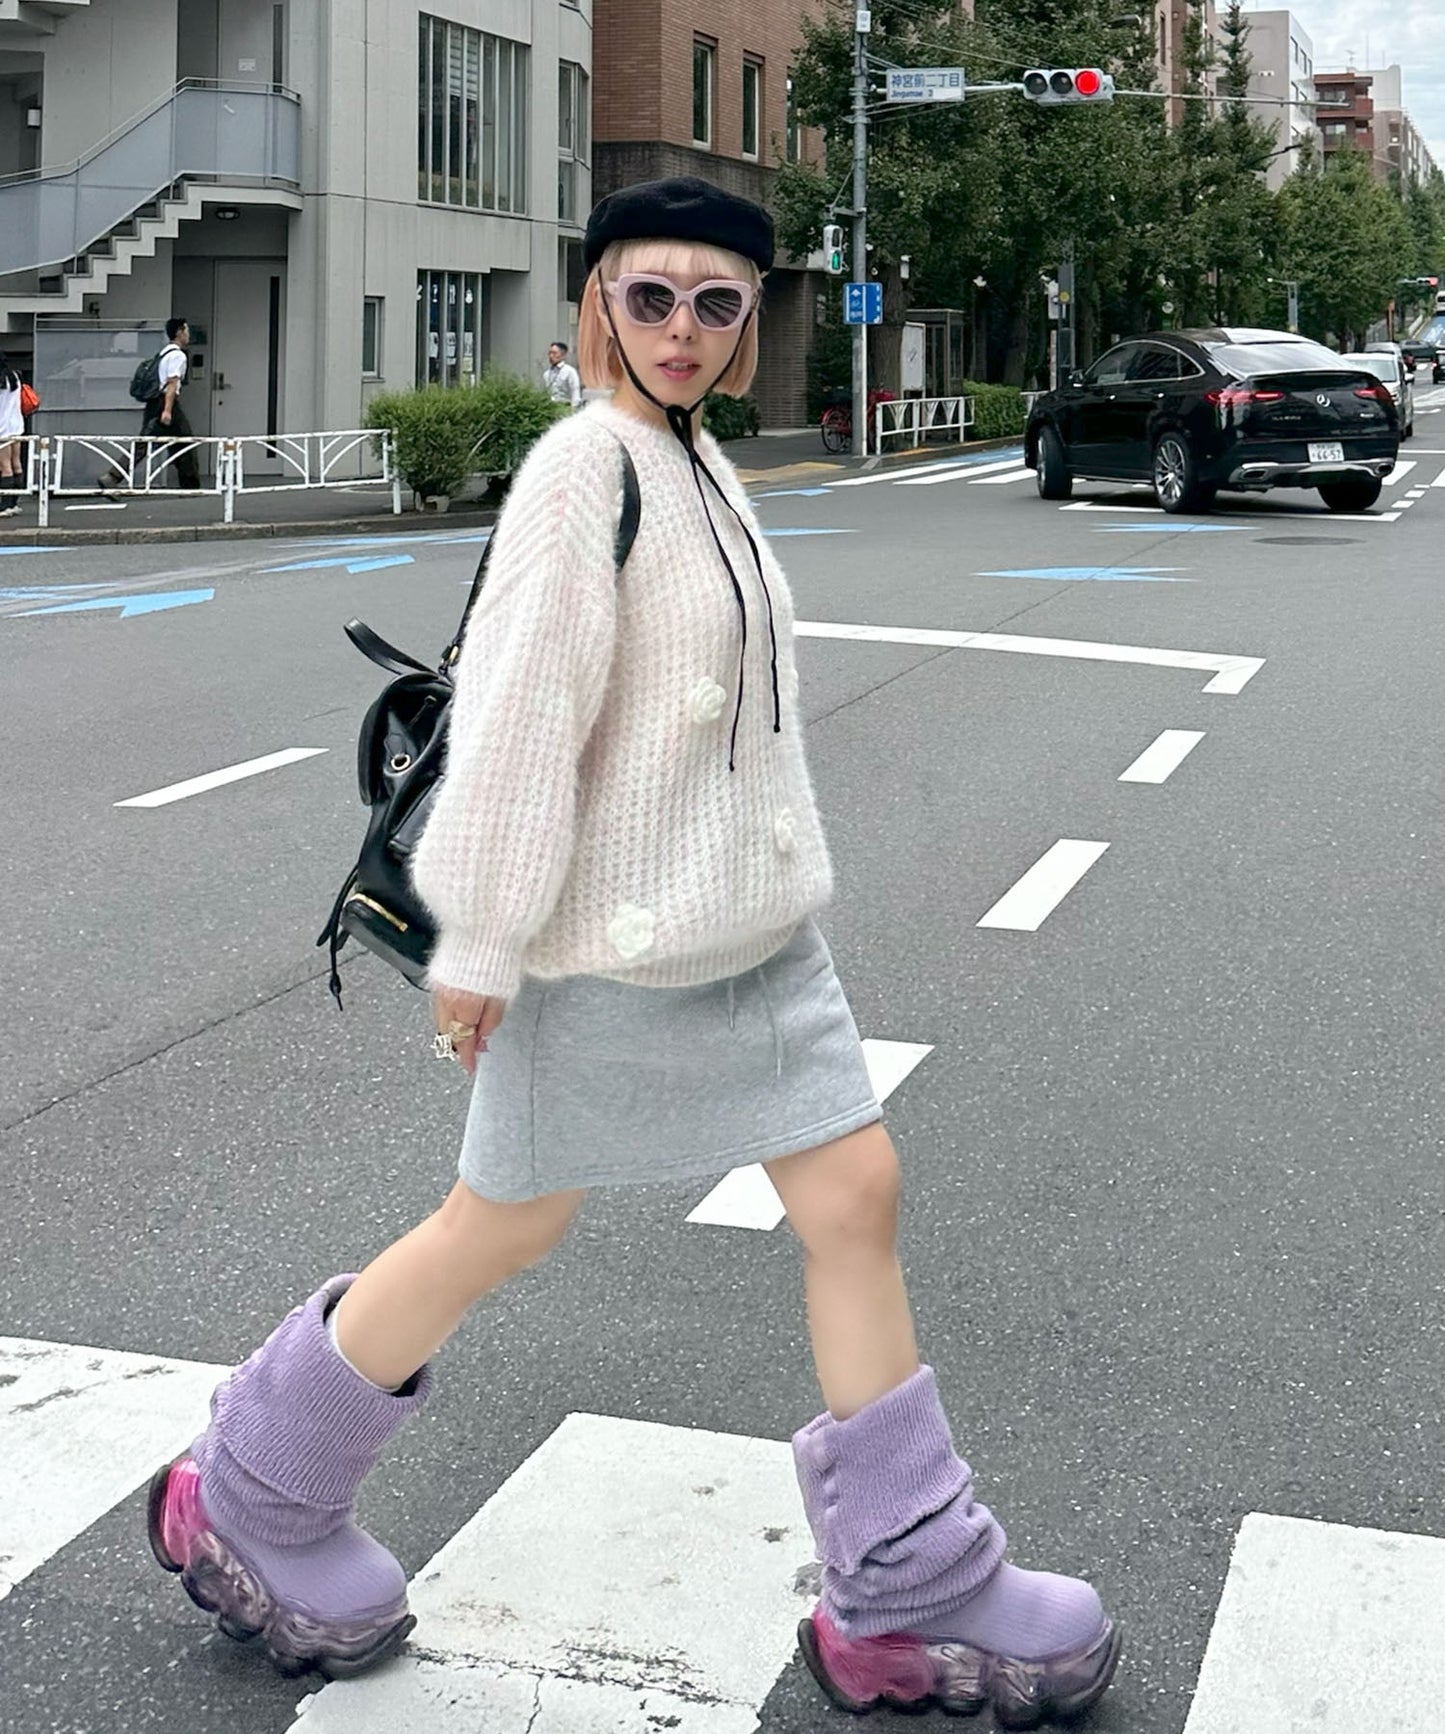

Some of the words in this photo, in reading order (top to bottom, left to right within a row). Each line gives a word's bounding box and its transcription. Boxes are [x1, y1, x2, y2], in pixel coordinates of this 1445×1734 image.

[891, 73, 960, 88] 神宮前二丁目
